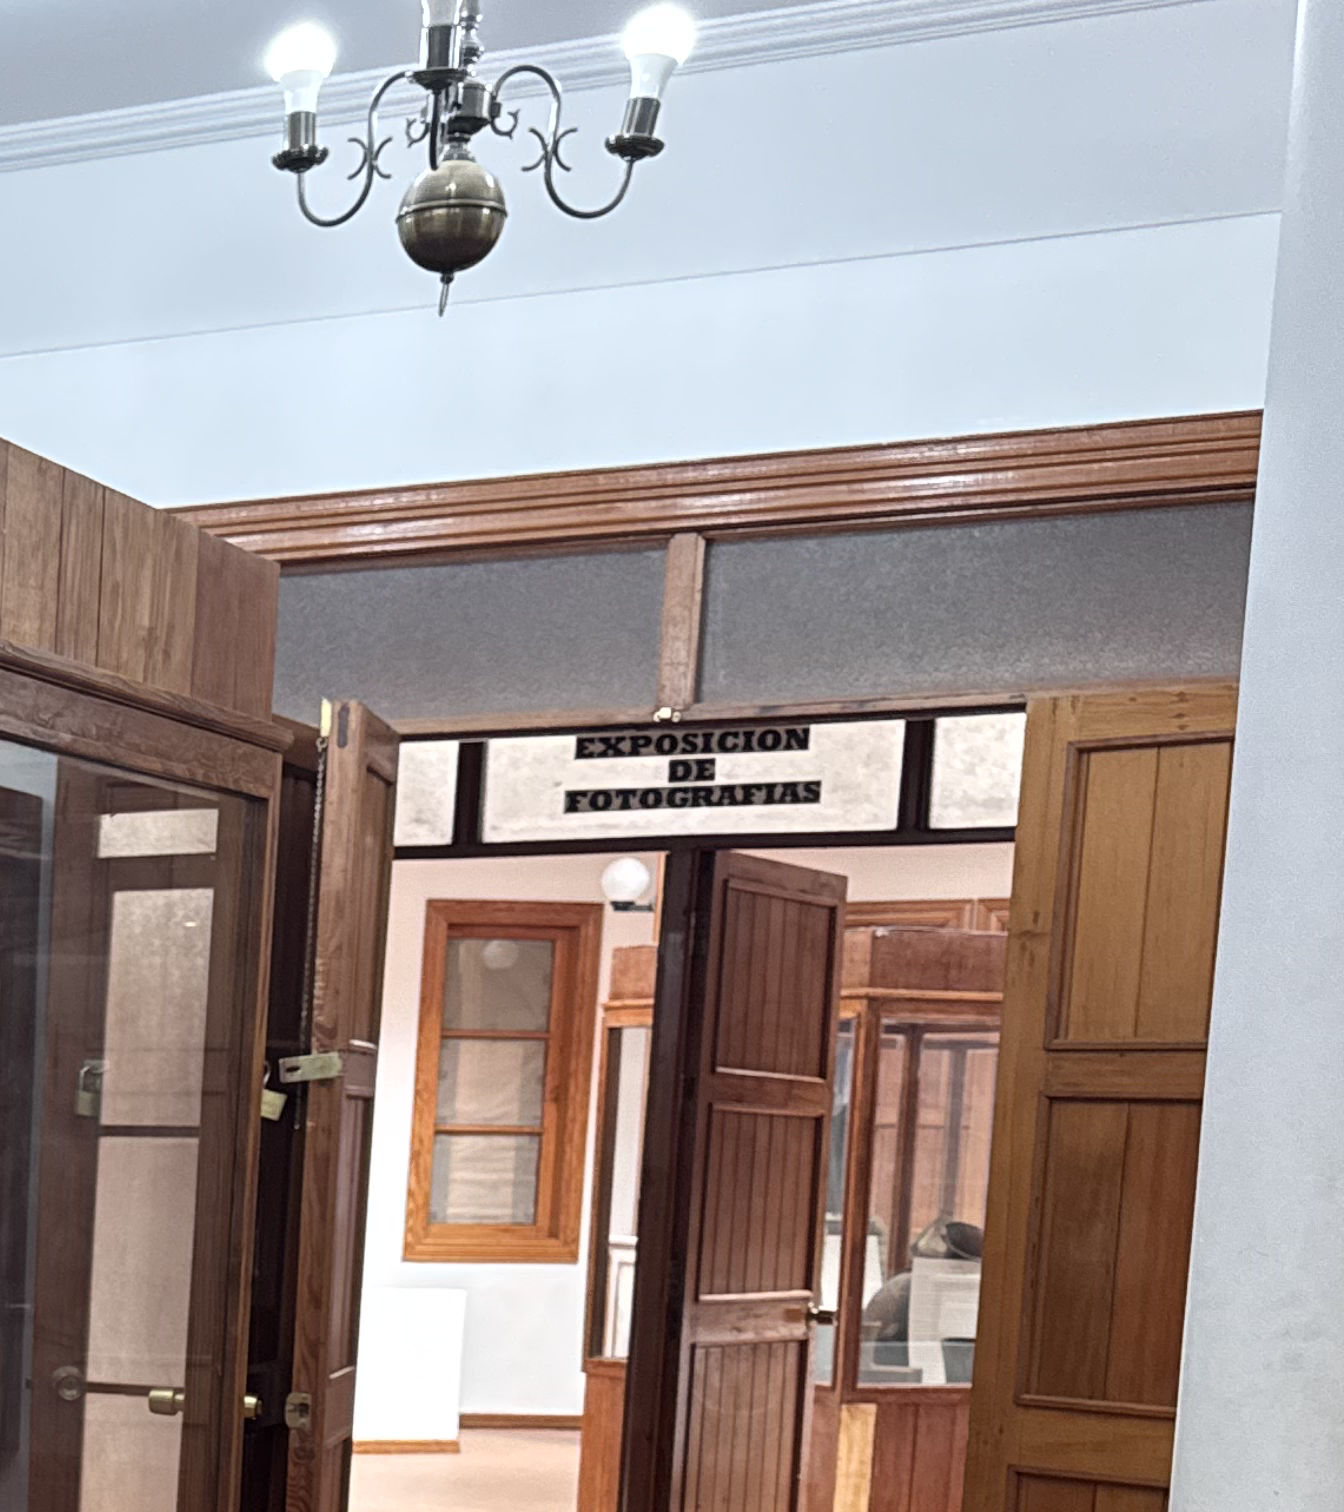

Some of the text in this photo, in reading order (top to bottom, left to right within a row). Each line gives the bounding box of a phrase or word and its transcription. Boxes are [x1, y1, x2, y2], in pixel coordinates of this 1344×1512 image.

[574, 726, 811, 759] EXPOSICION
[667, 758, 715, 782] DE
[563, 780, 822, 813] FOTOGRAFIAS
